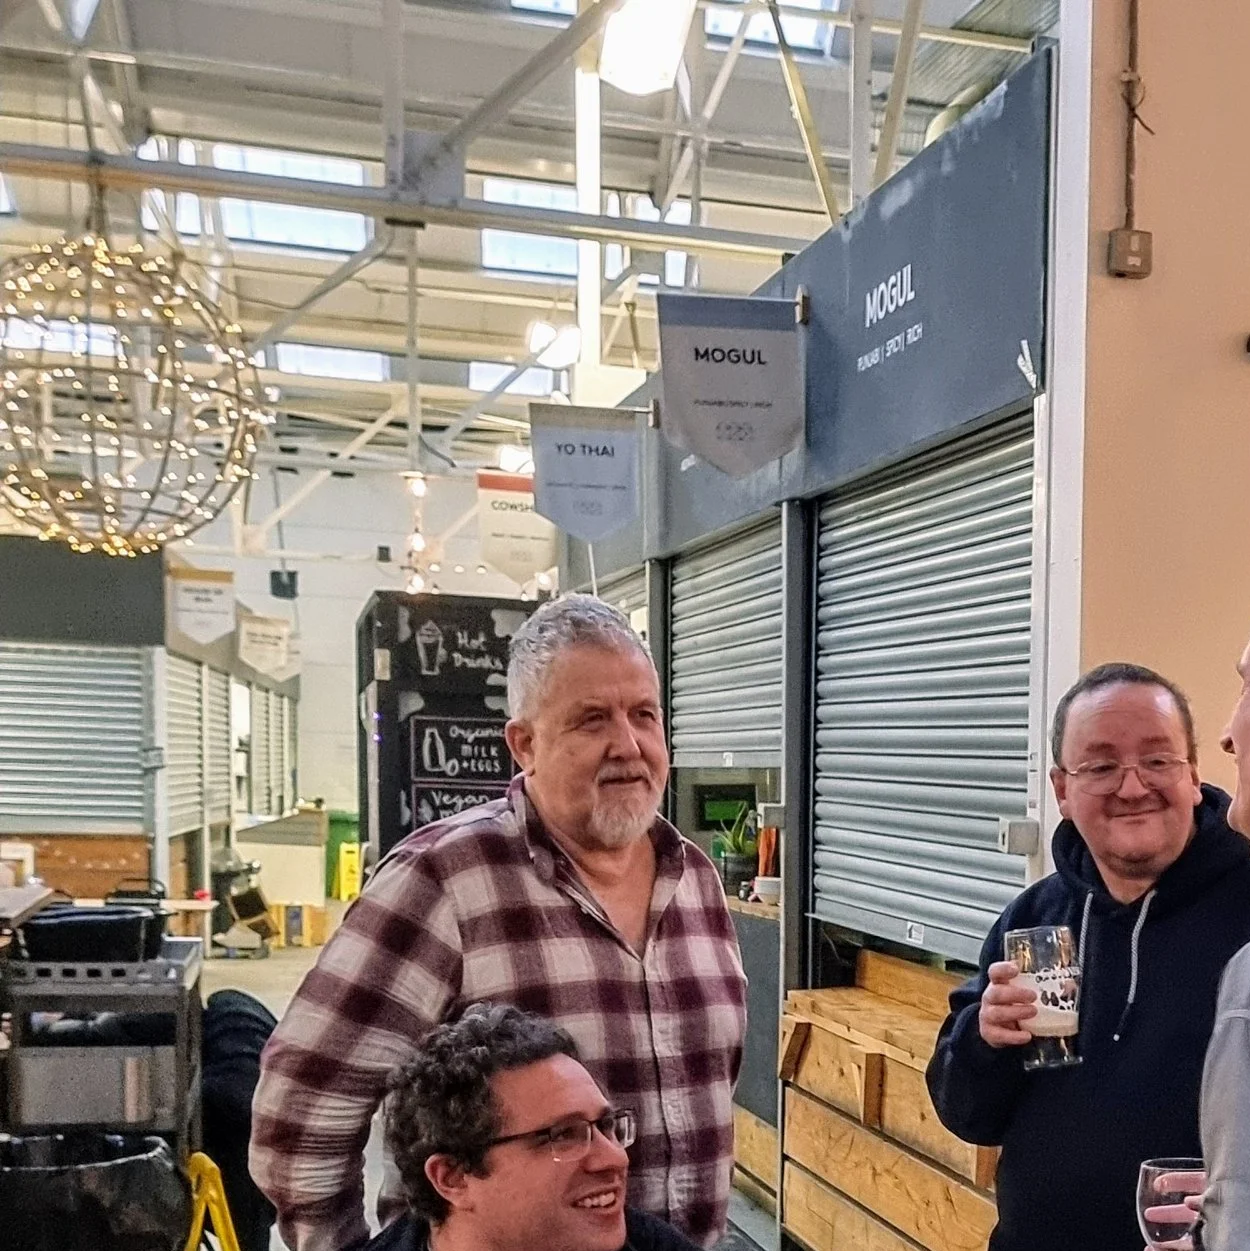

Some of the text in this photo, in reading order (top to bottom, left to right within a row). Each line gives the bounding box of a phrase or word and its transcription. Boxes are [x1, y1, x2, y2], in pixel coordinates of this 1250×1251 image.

[864, 263, 916, 328] MOGUL
[693, 347, 767, 366] MOGUL
[555, 443, 615, 457] YO THAI
[456, 631, 487, 652] Hot
[452, 652, 504, 671] Drinks
[449, 725, 506, 743] Organic
[431, 790, 490, 812] Vegan
